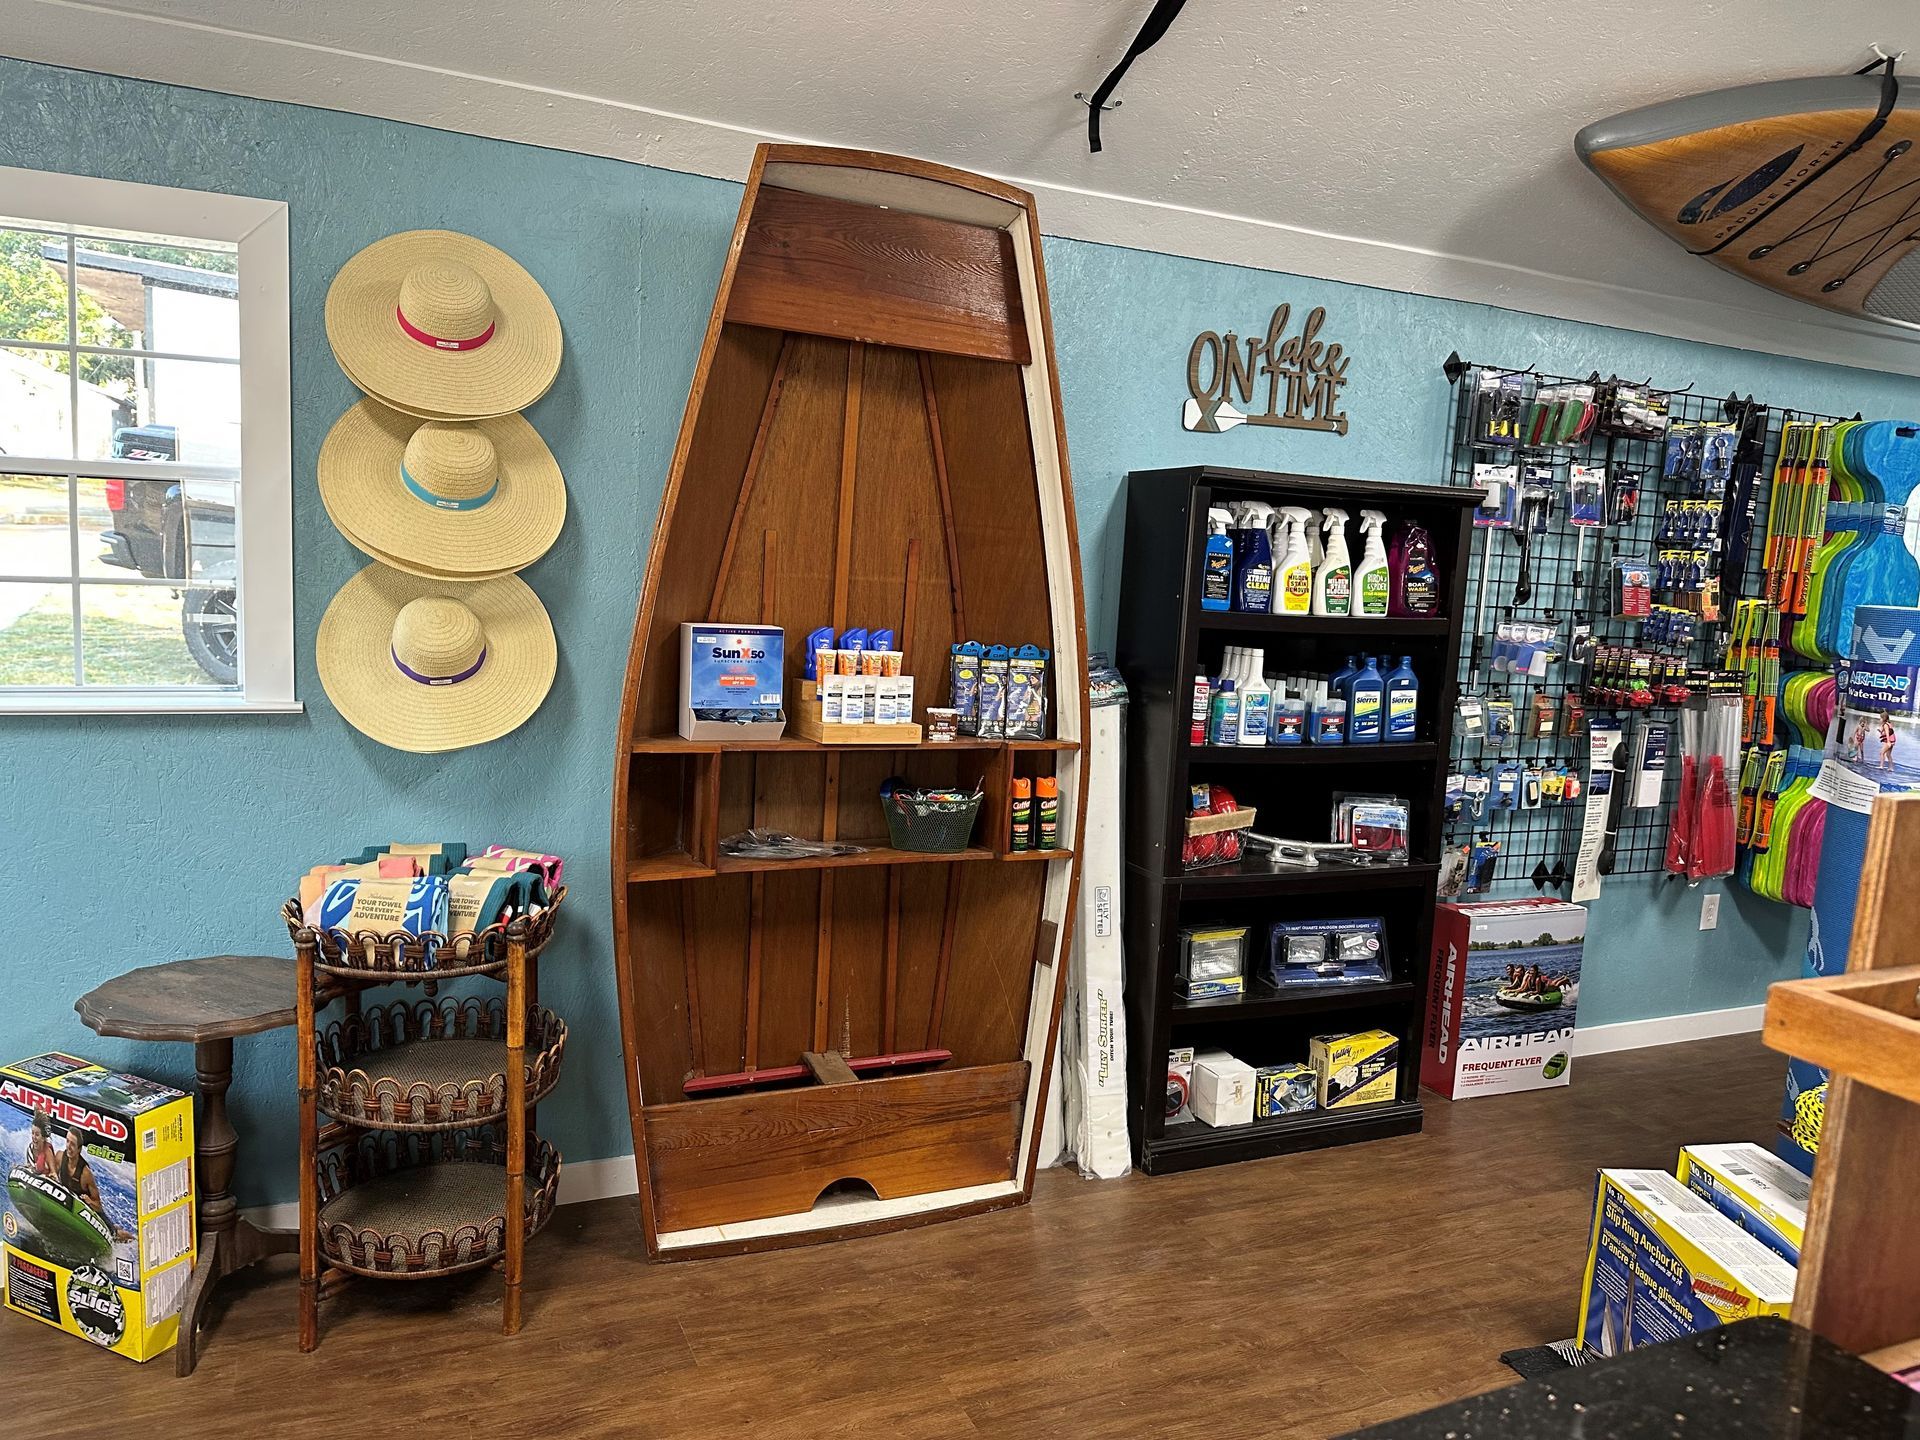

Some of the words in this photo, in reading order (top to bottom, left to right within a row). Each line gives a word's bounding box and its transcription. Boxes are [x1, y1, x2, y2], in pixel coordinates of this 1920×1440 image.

[1715, 192, 1779, 240] PADDLE
[1783, 140, 1845, 187] NORTH
[1187, 331, 1262, 403] ON
[1254, 303, 1351, 378] lake
[1261, 366, 1347, 421] TIME
[1246, 582, 1270, 590] CLEAN
[1850, 670, 1911, 691] AIRHEAD
[1848, 688, 1878, 700] Water
[1878, 692, 1908, 703] Mat
[358, 898, 377, 906] YOUR
[378, 900, 402, 908] TOWEL
[354, 912, 400, 922] ADVENTURE
[1431, 948, 1444, 1013] FREQUENT
[1438, 941, 1458, 1064] AIRHEAD
[1428, 1013, 1438, 1048] FLYER
[1458, 1027, 1574, 1051] AIRHEAD
[1462, 1060, 1514, 1072] FREQUENT
[1514, 1056, 1542, 1066] FLYER
[0, 1080, 128, 1142] AIRHEAD
[87, 1144, 125, 1164] SLICE
[10, 1168, 67, 1202] AIRHEAD
[1689, 1160, 1702, 1179] No.
[1703, 1172, 1712, 1186] 13
[1606, 1184, 1616, 1199] No.
[1690, 1180, 1712, 1200] COMPLETE
[1606, 1204, 1621, 1228] Slip
[1621, 1216, 1640, 1244] Ring
[1640, 1234, 1670, 1263] Anchor
[1670, 1258, 1683, 1279] Kit
[1602, 1234, 1629, 1264] D'ancre
[1629, 1258, 1635, 1270] à
[1635, 1261, 1658, 1290] bague
[1658, 1286, 1694, 1322] glissante
[69, 1289, 122, 1318] SLICE
